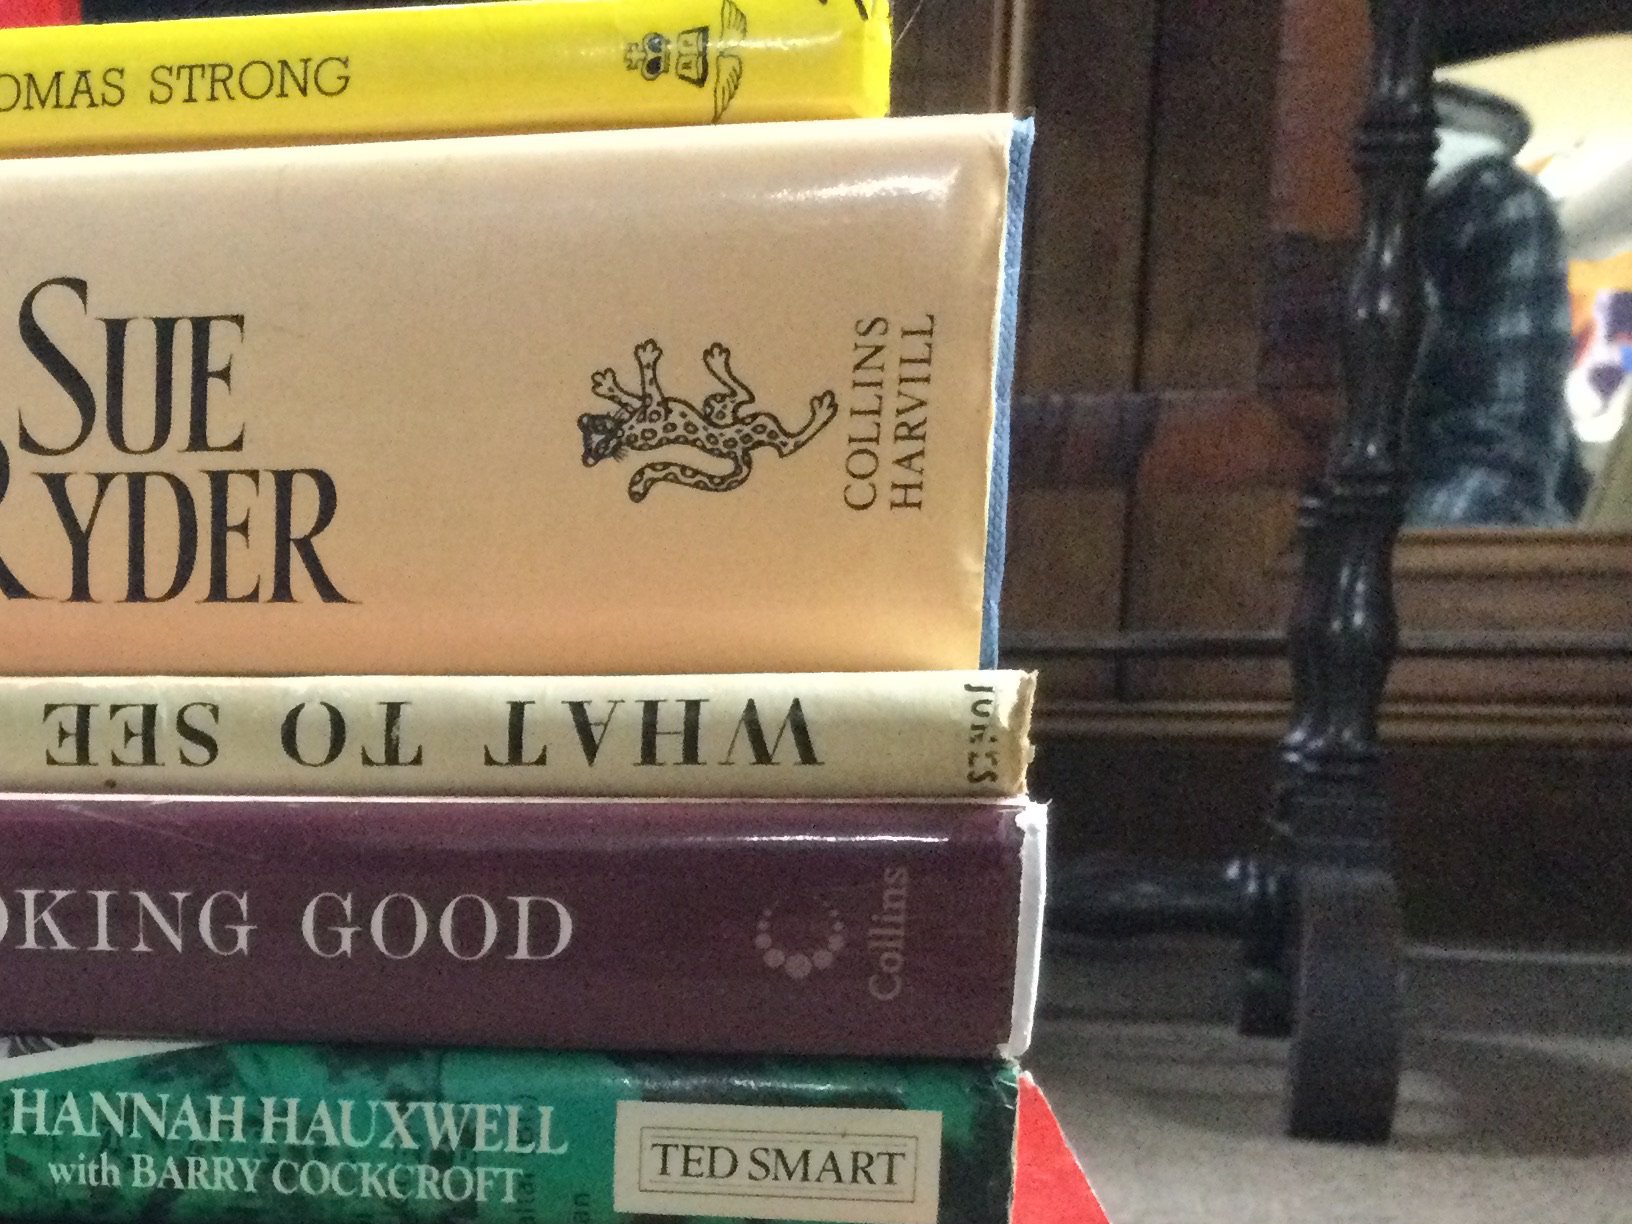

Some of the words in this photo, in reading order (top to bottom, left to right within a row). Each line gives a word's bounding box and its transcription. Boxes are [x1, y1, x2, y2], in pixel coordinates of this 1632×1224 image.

[149, 56, 351, 105] STRONG
[18, 276, 245, 456] SUE
[843, 316, 890, 511] COLLINS
[890, 312, 935, 511] HARVILL
[44, 702, 221, 767] SEE
[281, 700, 424, 766] TO
[483, 696, 826, 766] WHAT
[301, 892, 575, 961] GOOD
[868, 867, 909, 1001] Collins
[8, 1086, 247, 1145] HANNAH
[259, 1095, 568, 1156] HAUXWELL
[46, 1151, 123, 1190] with
[132, 1153, 264, 1197] BARRY
[272, 1156, 525, 1204] COCKCROFT
[652, 1141, 739, 1183] TED
[746, 1145, 908, 1188] SMART
